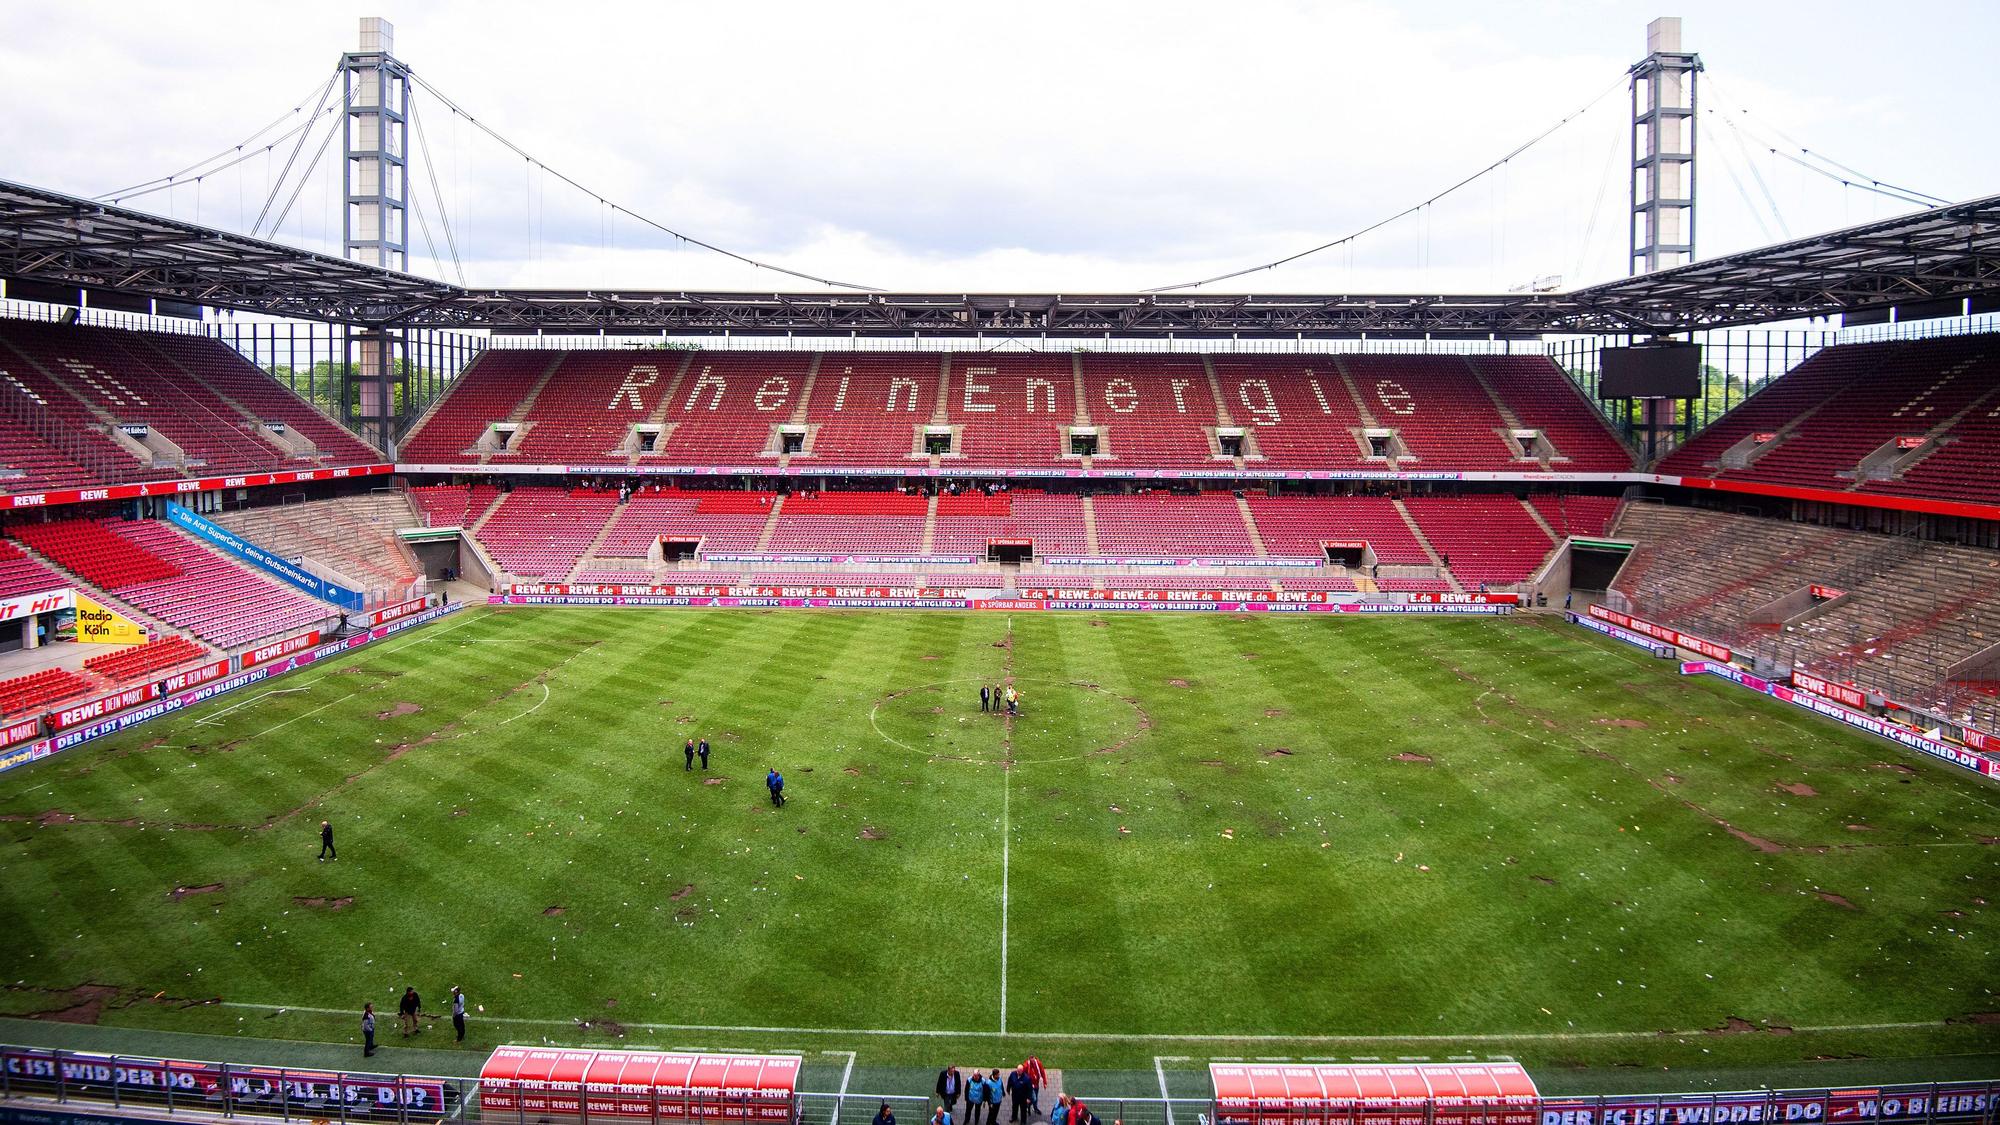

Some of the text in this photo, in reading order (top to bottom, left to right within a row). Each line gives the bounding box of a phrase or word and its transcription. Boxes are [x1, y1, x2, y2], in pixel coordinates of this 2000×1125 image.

[297, 471, 314, 481] REWE
[333, 469, 349, 477] REWE
[177, 481, 201, 492] REWE
[225, 477, 246, 487] REWE
[80, 489, 109, 501] REWE
[14, 494, 46, 507] REWE
[180, 512, 193, 524] Die
[193, 517, 208, 532] Aral
[207, 526, 244, 553] SuperCard,
[245, 546, 264, 562] deine
[264, 556, 319, 590] Gutscheinkarte!
[516, 586, 561, 595] REWE.de
[568, 586, 614, 595] REWE.de
[621, 586, 667, 596] REWE.de
[675, 586, 720, 596] REWE.de
[728, 587, 773, 597] REWE.de
[782, 587, 827, 597] REWE.de
[835, 588, 881, 598] REWE.de
[1059, 589, 1104, 599] REWE.de
[1113, 590, 1159, 600] REWE.de
[526, 597, 614, 605] DER FC IST WIDDER DO
[624, 597, 690, 605] WO BLEIBST DU?
[1167, 591, 1213, 601] REWE.de
[1221, 592, 1268, 602] REWE.de
[1276, 592, 1323, 602] REWE.de
[1440, 594, 1487, 604] REWE.de
[31, 596, 65, 613] HIT
[738, 599, 779, 607] WERDE FC
[828, 600, 966, 608] ALLE INFOS UNTER FC-MITGLIED.DE
[988, 600, 1038, 609] SPÜRBAR ANDERS.
[1267, 603, 1308, 611] WERDE FC
[80, 609, 113, 621] Radio
[382, 606, 402, 620] REWE
[1589, 605, 1609, 619] REWE
[84, 624, 110, 635] Köln
[386, 623, 401, 634] ALLE
[401, 617, 418, 630] INFOS
[1630, 618, 1652, 635] REWE
[1677, 634, 1702, 652] REWE
[254, 643, 283, 663] REWE
[314, 640, 349, 659] WERDE FC
[1704, 662, 1743, 683] WERDE FC
[151, 664, 219, 697] RWE DEIN MARKT
[195, 668, 268, 701] WO BLEIBST DU?
[1793, 672, 1825, 694] REWE
[61, 689, 144, 727] REWE DEIN MARKT
[57, 698, 183, 749] DER FC IST WIDDER DO
[10, 721, 37, 743] MARKT
[1791, 692, 1978, 769] ALLE INFOS UNTER FC-MITGLIED.DE
[0, 751, 32, 769] irchen
[498, 1050, 526, 1059] REWE
[530, 1051, 558, 1060] REWE
[563, 1053, 591, 1062] REWE
[598, 1054, 626, 1063] REWE
[631, 1055, 660, 1064] REWE
[25, 1058, 196, 1089] IST WIDDER DO
[484, 1078, 511, 1088] REWE
[551, 1081, 579, 1091] REWE
[587, 1082, 615, 1093] REWE
[620, 1084, 649, 1094] REWE
[761, 1088, 789, 1098] REWE
[378, 1086, 428, 1108] DU?
[484, 1097, 512, 1106] REWE
[1221, 1097, 1250, 1107] REWE
[1436, 1096, 1464, 1106] REWE
[1505, 1094, 1534, 1105] REWE
[552, 1100, 579, 1110] REWE
[587, 1102, 615, 1111] REWE
[621, 1104, 649, 1112] REWE
[1858, 1100, 1901, 1117] WO
[1543, 1102, 1822, 1125] DER FC IST WIDDER DO
[1436, 1116, 1463, 1125] REWE
[1505, 1115, 1532, 1124] REWE
